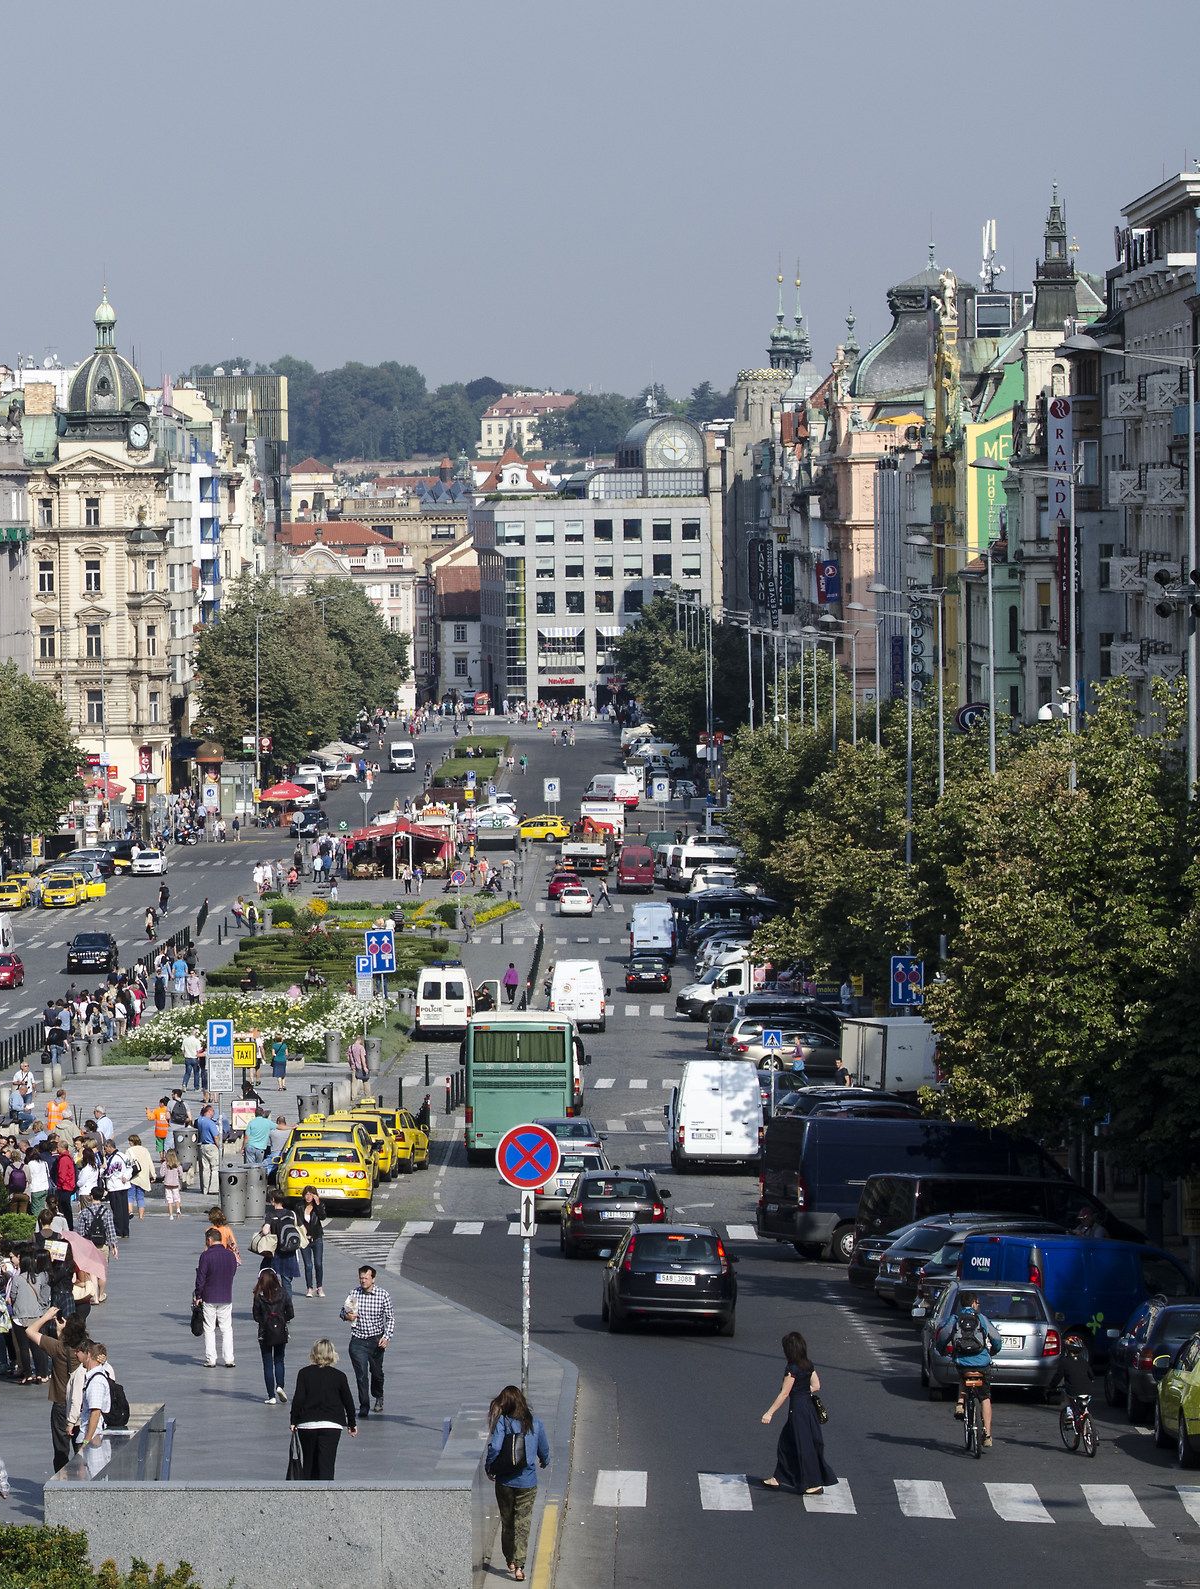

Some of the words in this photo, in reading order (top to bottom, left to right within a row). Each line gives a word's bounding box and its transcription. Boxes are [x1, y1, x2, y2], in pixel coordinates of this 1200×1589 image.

[1053, 428, 1067, 519] RAMADA
[783, 562, 792, 604] GATE
[768, 581, 779, 625] RESERVED
[359, 958, 370, 972] P
[212, 1024, 228, 1045] P
[236, 1050, 251, 1059] TAXI
[971, 1256, 991, 1267] OKIN
